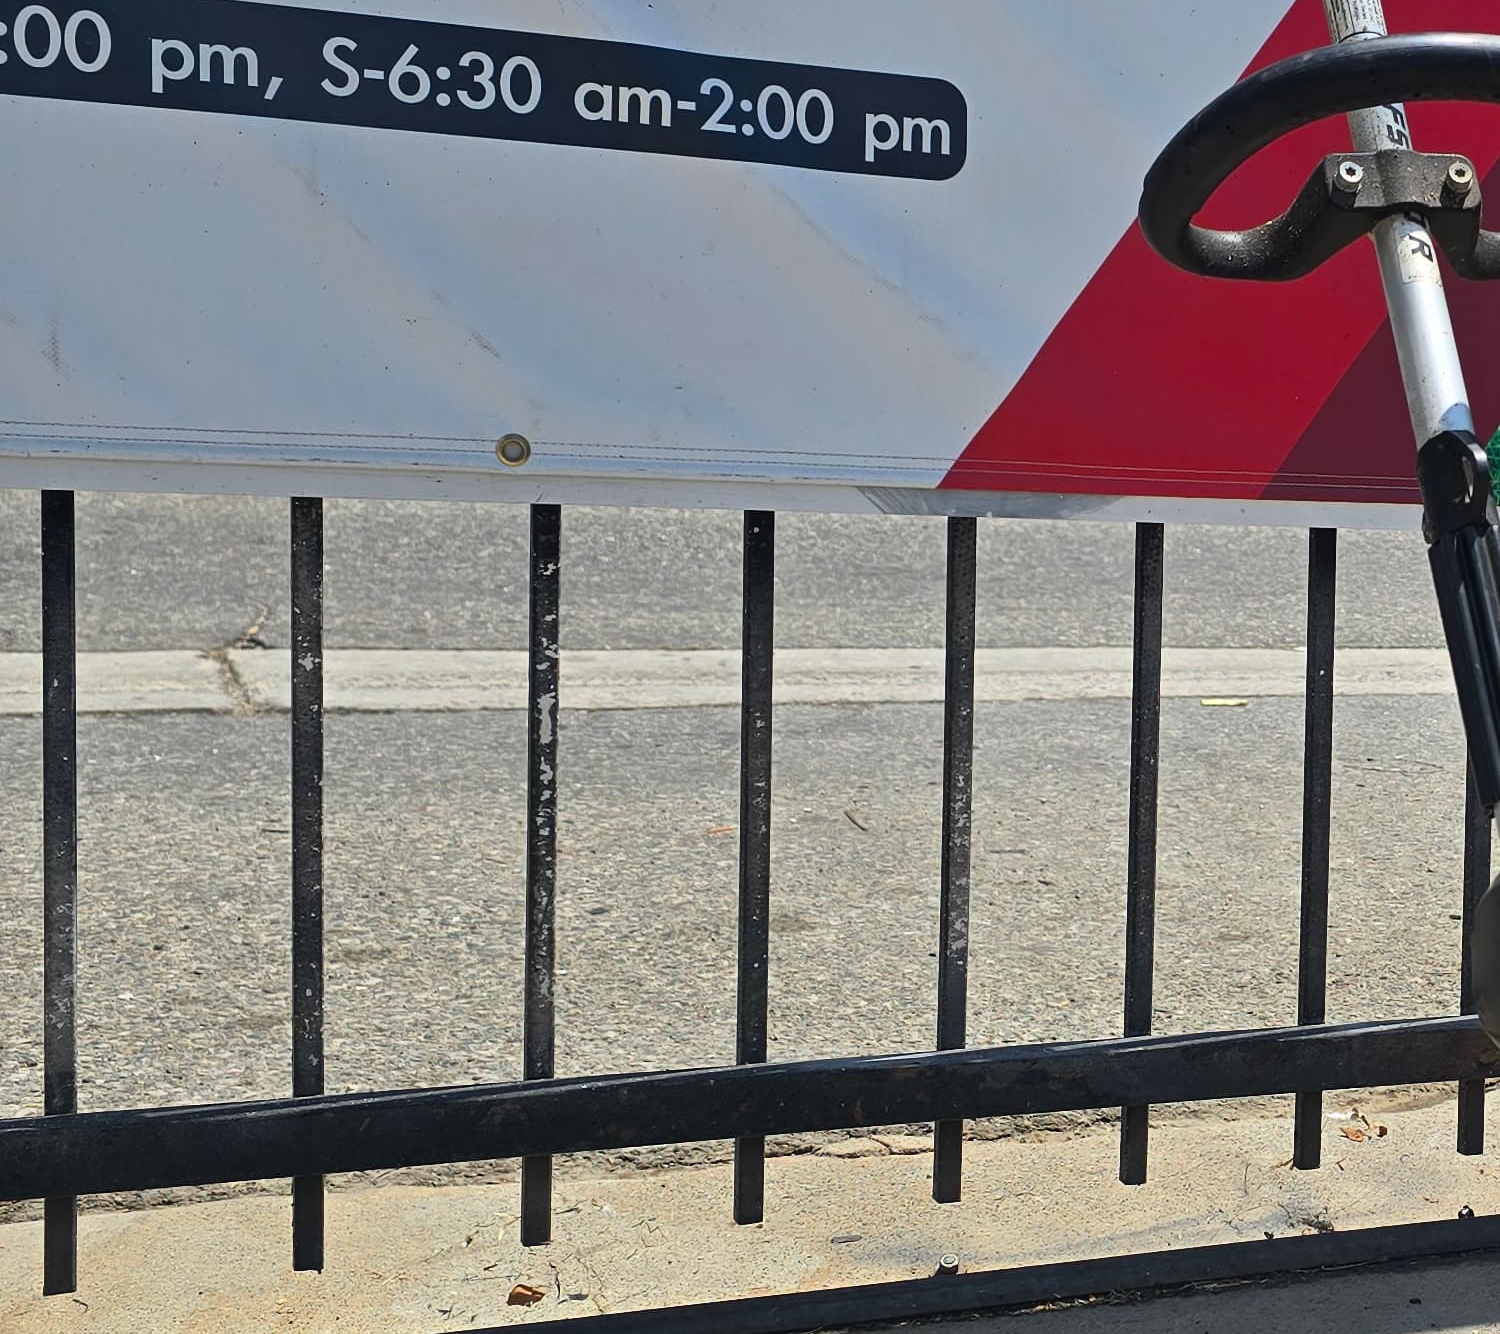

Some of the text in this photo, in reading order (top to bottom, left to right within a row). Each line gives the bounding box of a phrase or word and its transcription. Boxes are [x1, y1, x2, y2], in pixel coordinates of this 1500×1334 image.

[152, 37, 284, 100] pm,
[321, 37, 542, 114] S-6:30
[575, 78, 834, 144] am-2:00
[865, 112, 950, 162] pm
